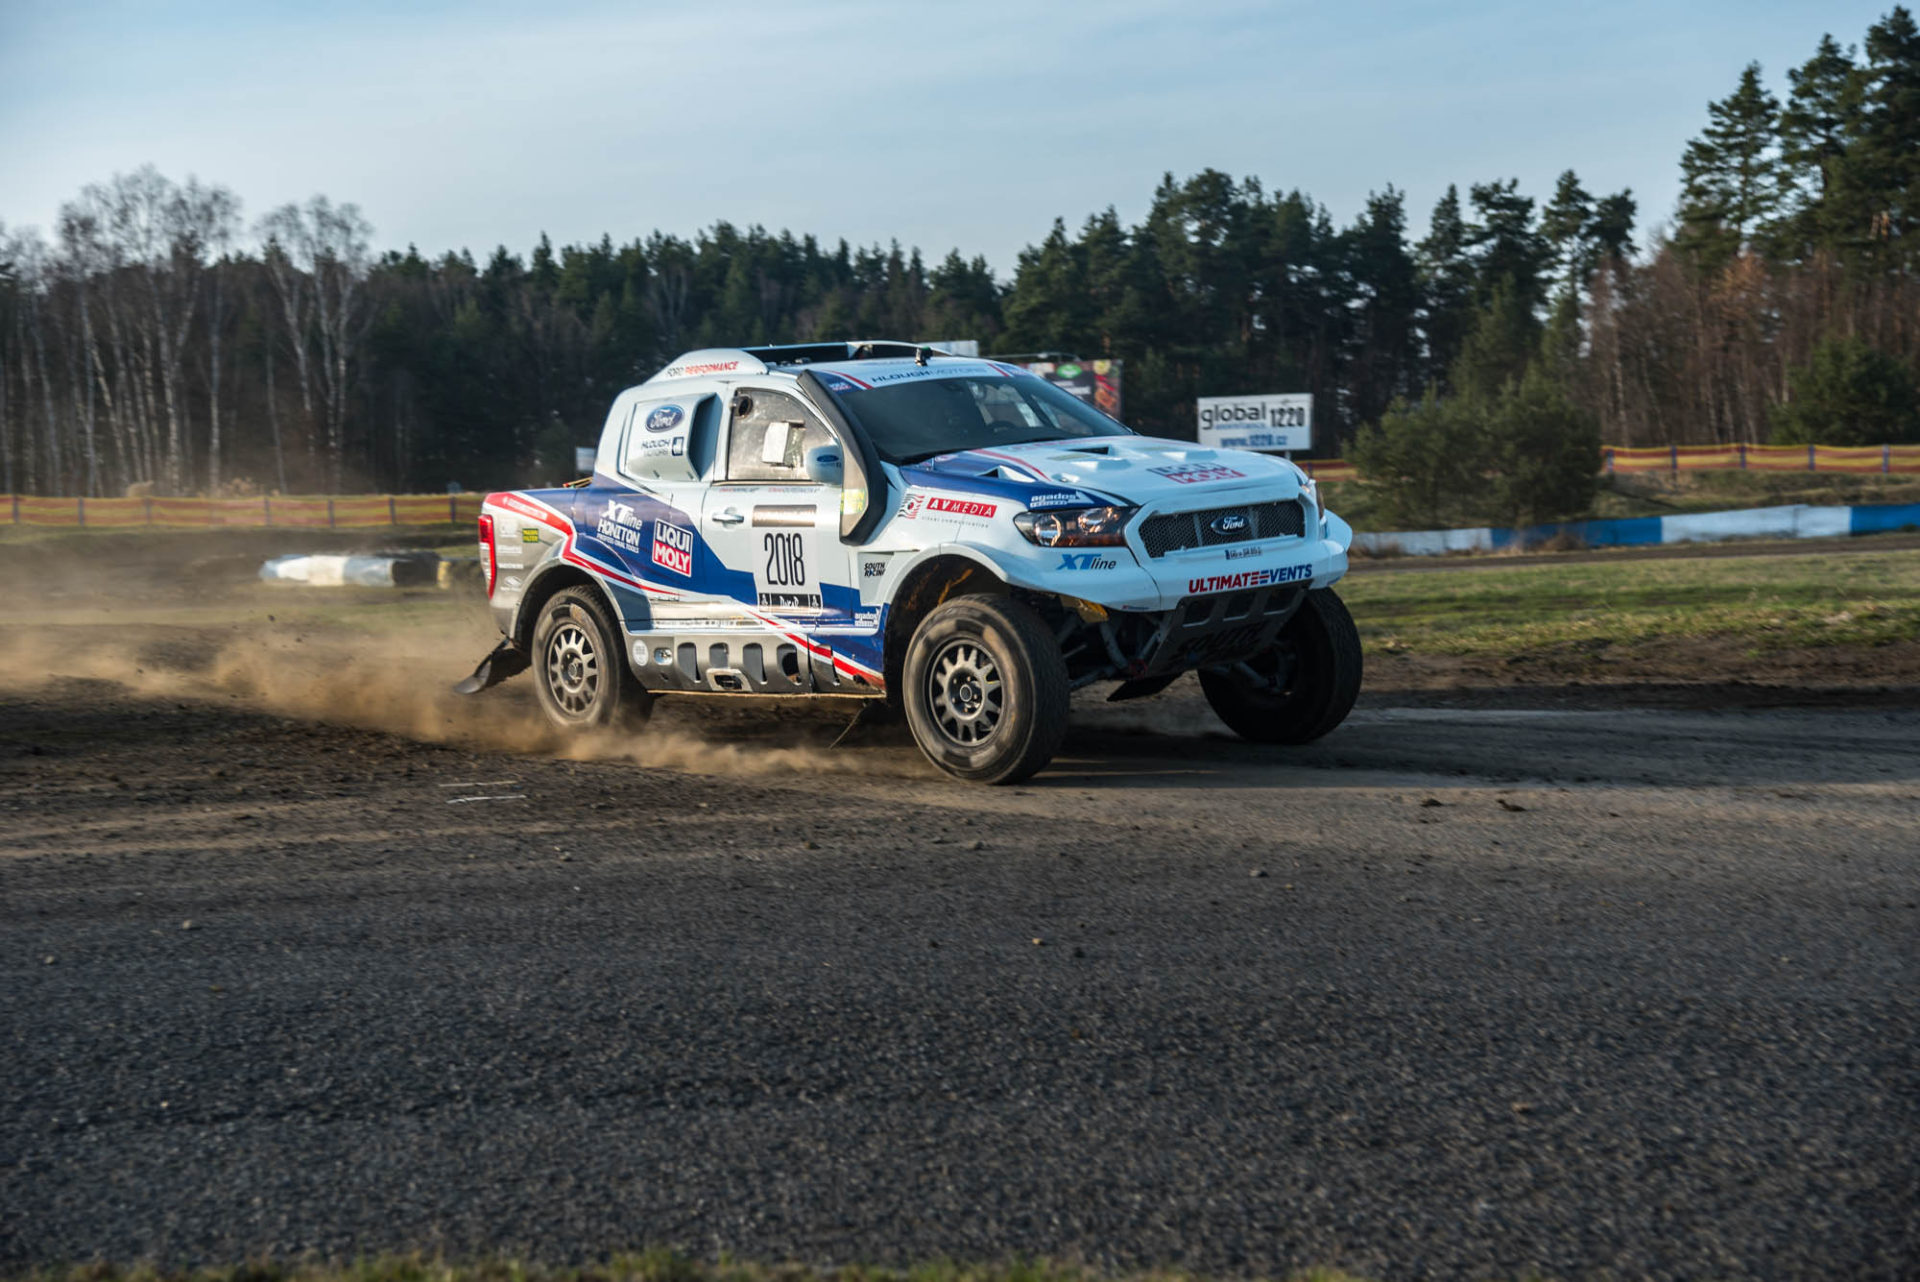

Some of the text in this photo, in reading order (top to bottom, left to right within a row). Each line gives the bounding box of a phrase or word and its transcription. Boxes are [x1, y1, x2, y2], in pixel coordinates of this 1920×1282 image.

[649, 408, 678, 429] Ford
[1201, 402, 1305, 430] global 1220
[597, 518, 641, 547] HONITON
[656, 522, 691, 552] LIQUI
[1222, 516, 1245, 530] Ford
[655, 543, 690, 572] MOLY
[764, 533, 806, 586] 2018
[1056, 553, 1117, 570] XTline
